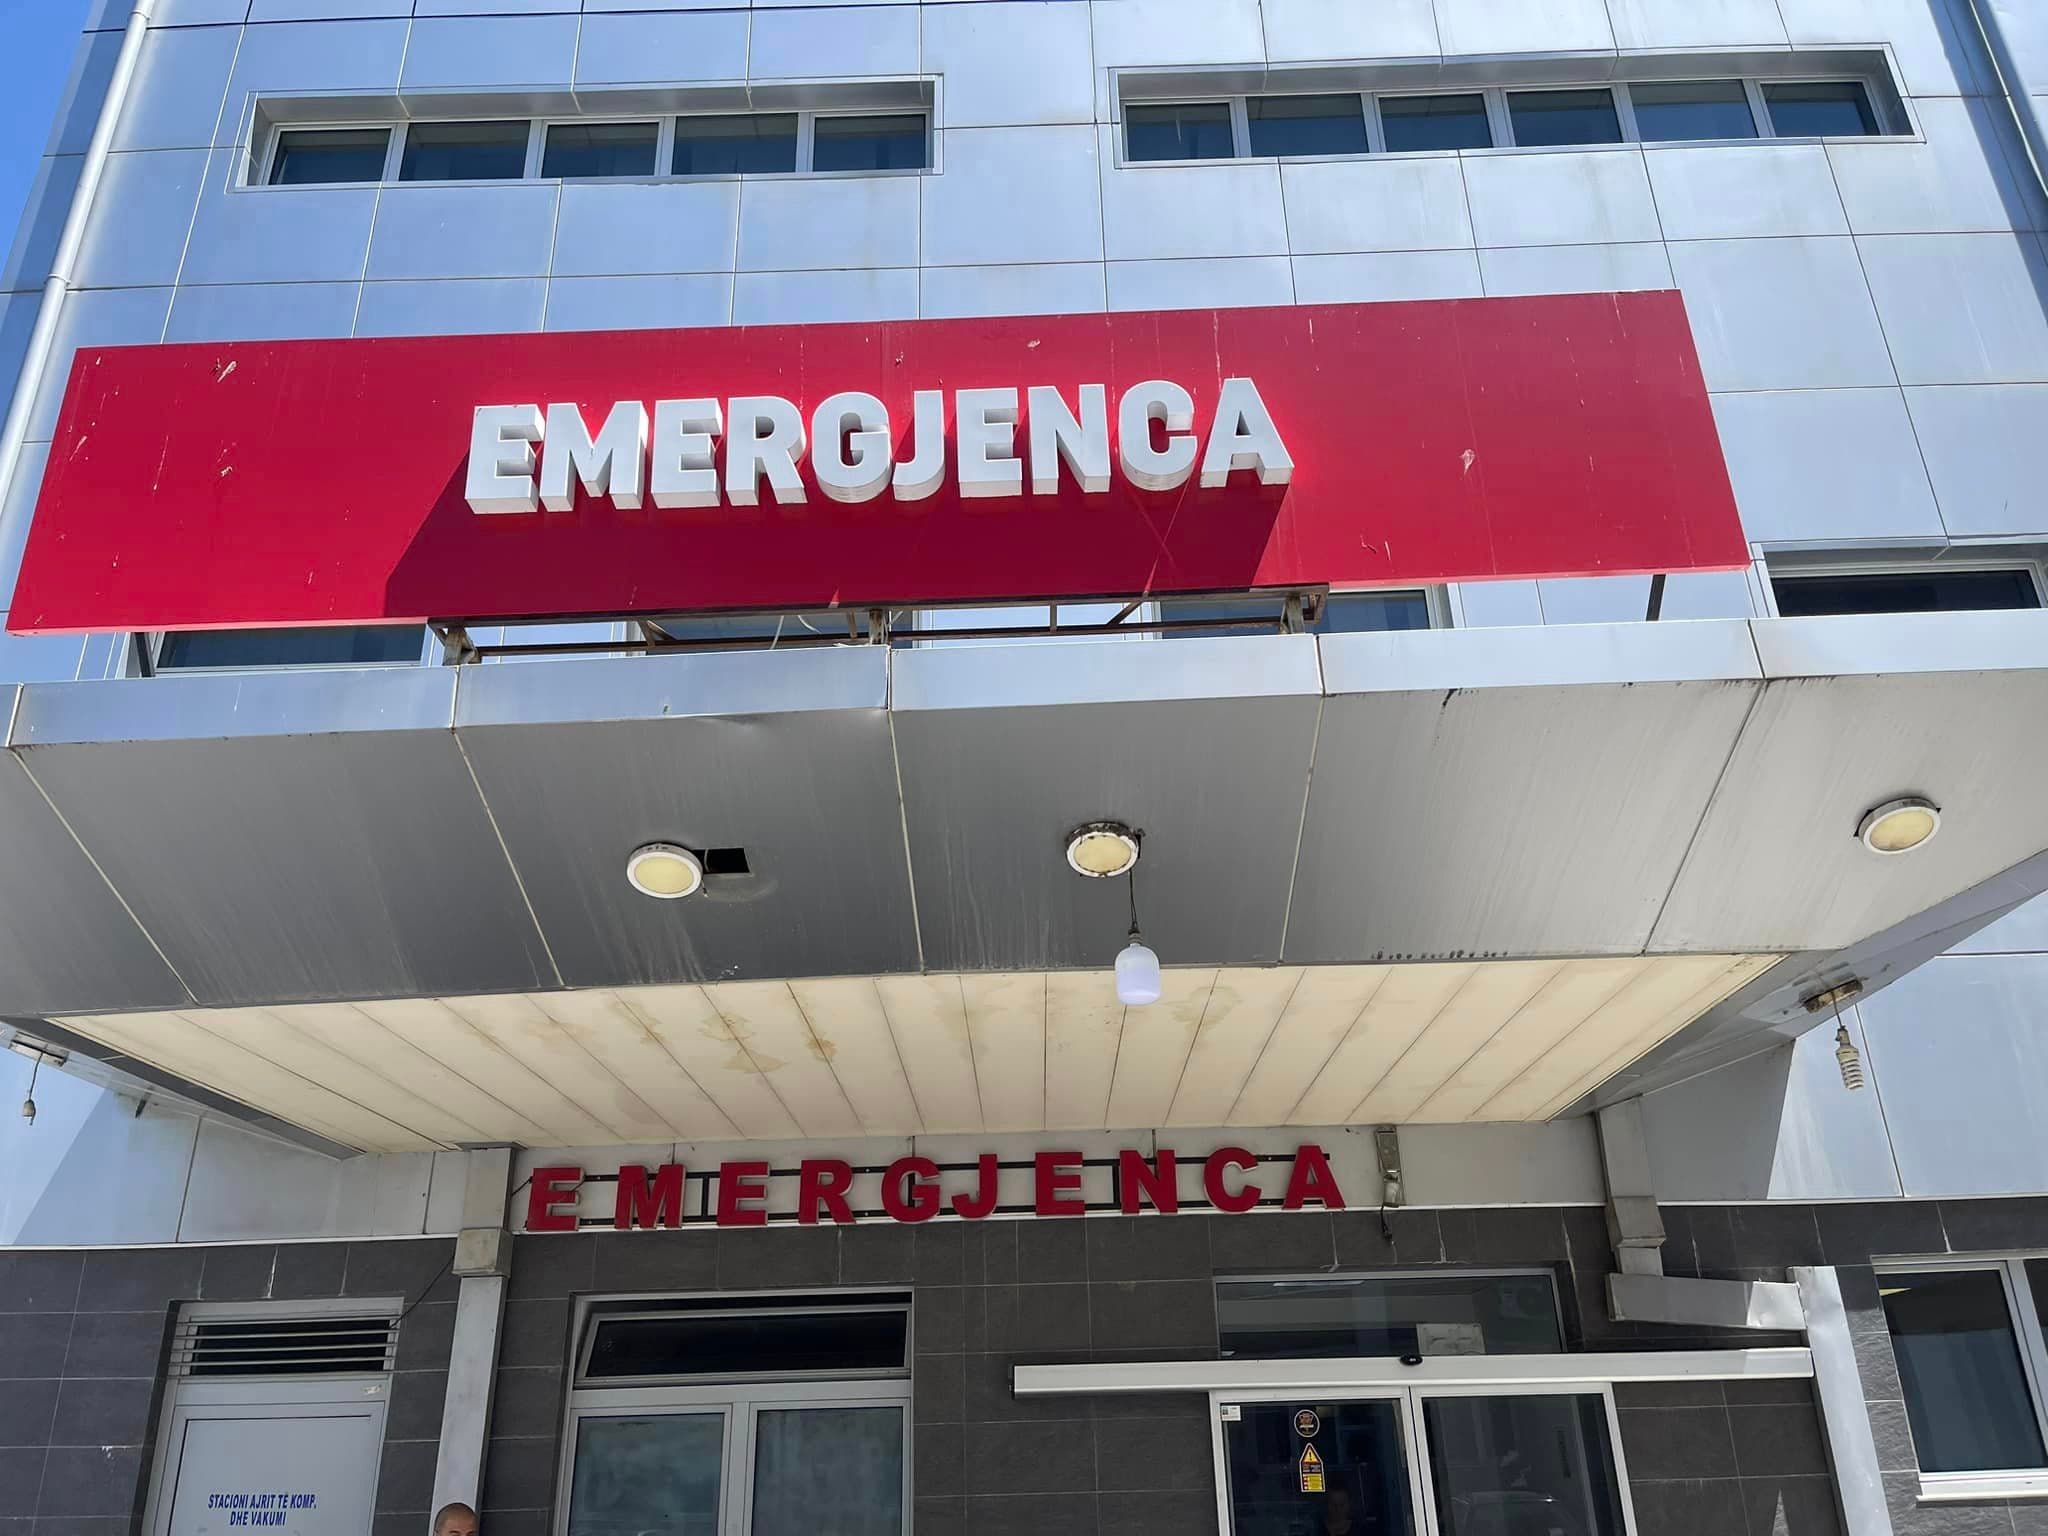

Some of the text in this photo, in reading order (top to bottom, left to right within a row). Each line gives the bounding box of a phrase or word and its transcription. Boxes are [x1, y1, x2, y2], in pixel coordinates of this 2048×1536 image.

[464, 377, 1295, 514] EMERGJENCA
[527, 1145, 1345, 1231] EMERGJENCA
[208, 1494, 248, 1508] STACIONI
[250, 1494, 276, 1508] AJRIT
[290, 1494, 317, 1508] KOMP.
[229, 1511, 286, 1525] DHE VAKUMI
